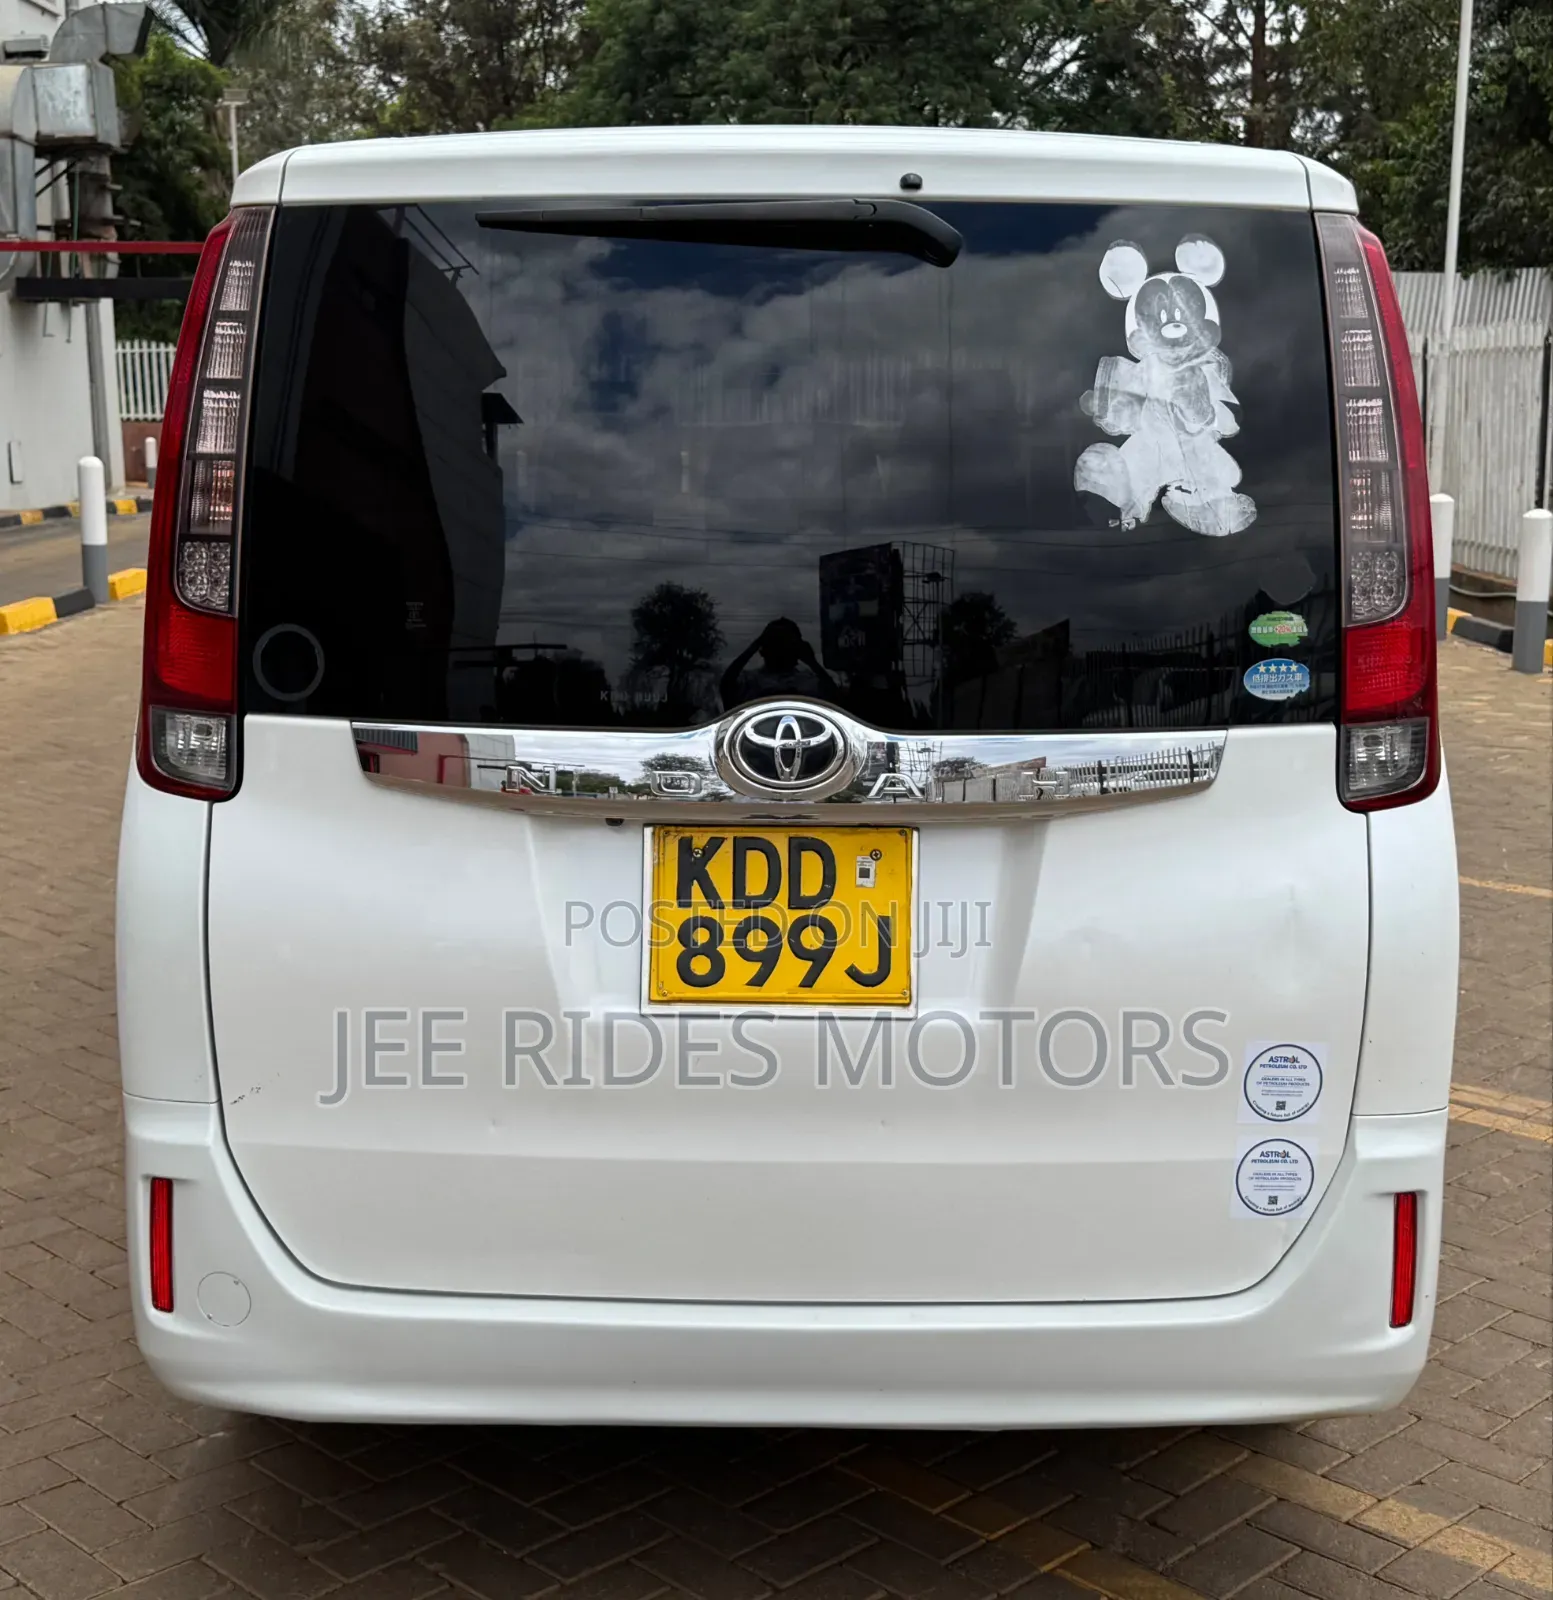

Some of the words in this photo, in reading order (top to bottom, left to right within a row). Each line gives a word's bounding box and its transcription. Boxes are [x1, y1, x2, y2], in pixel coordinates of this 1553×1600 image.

[676, 836, 837, 910] KDD
[676, 915, 892, 988] 899J
[1268, 1055, 1300, 1063] ASTROL
[1260, 1150, 1291, 1158] ASTROL
